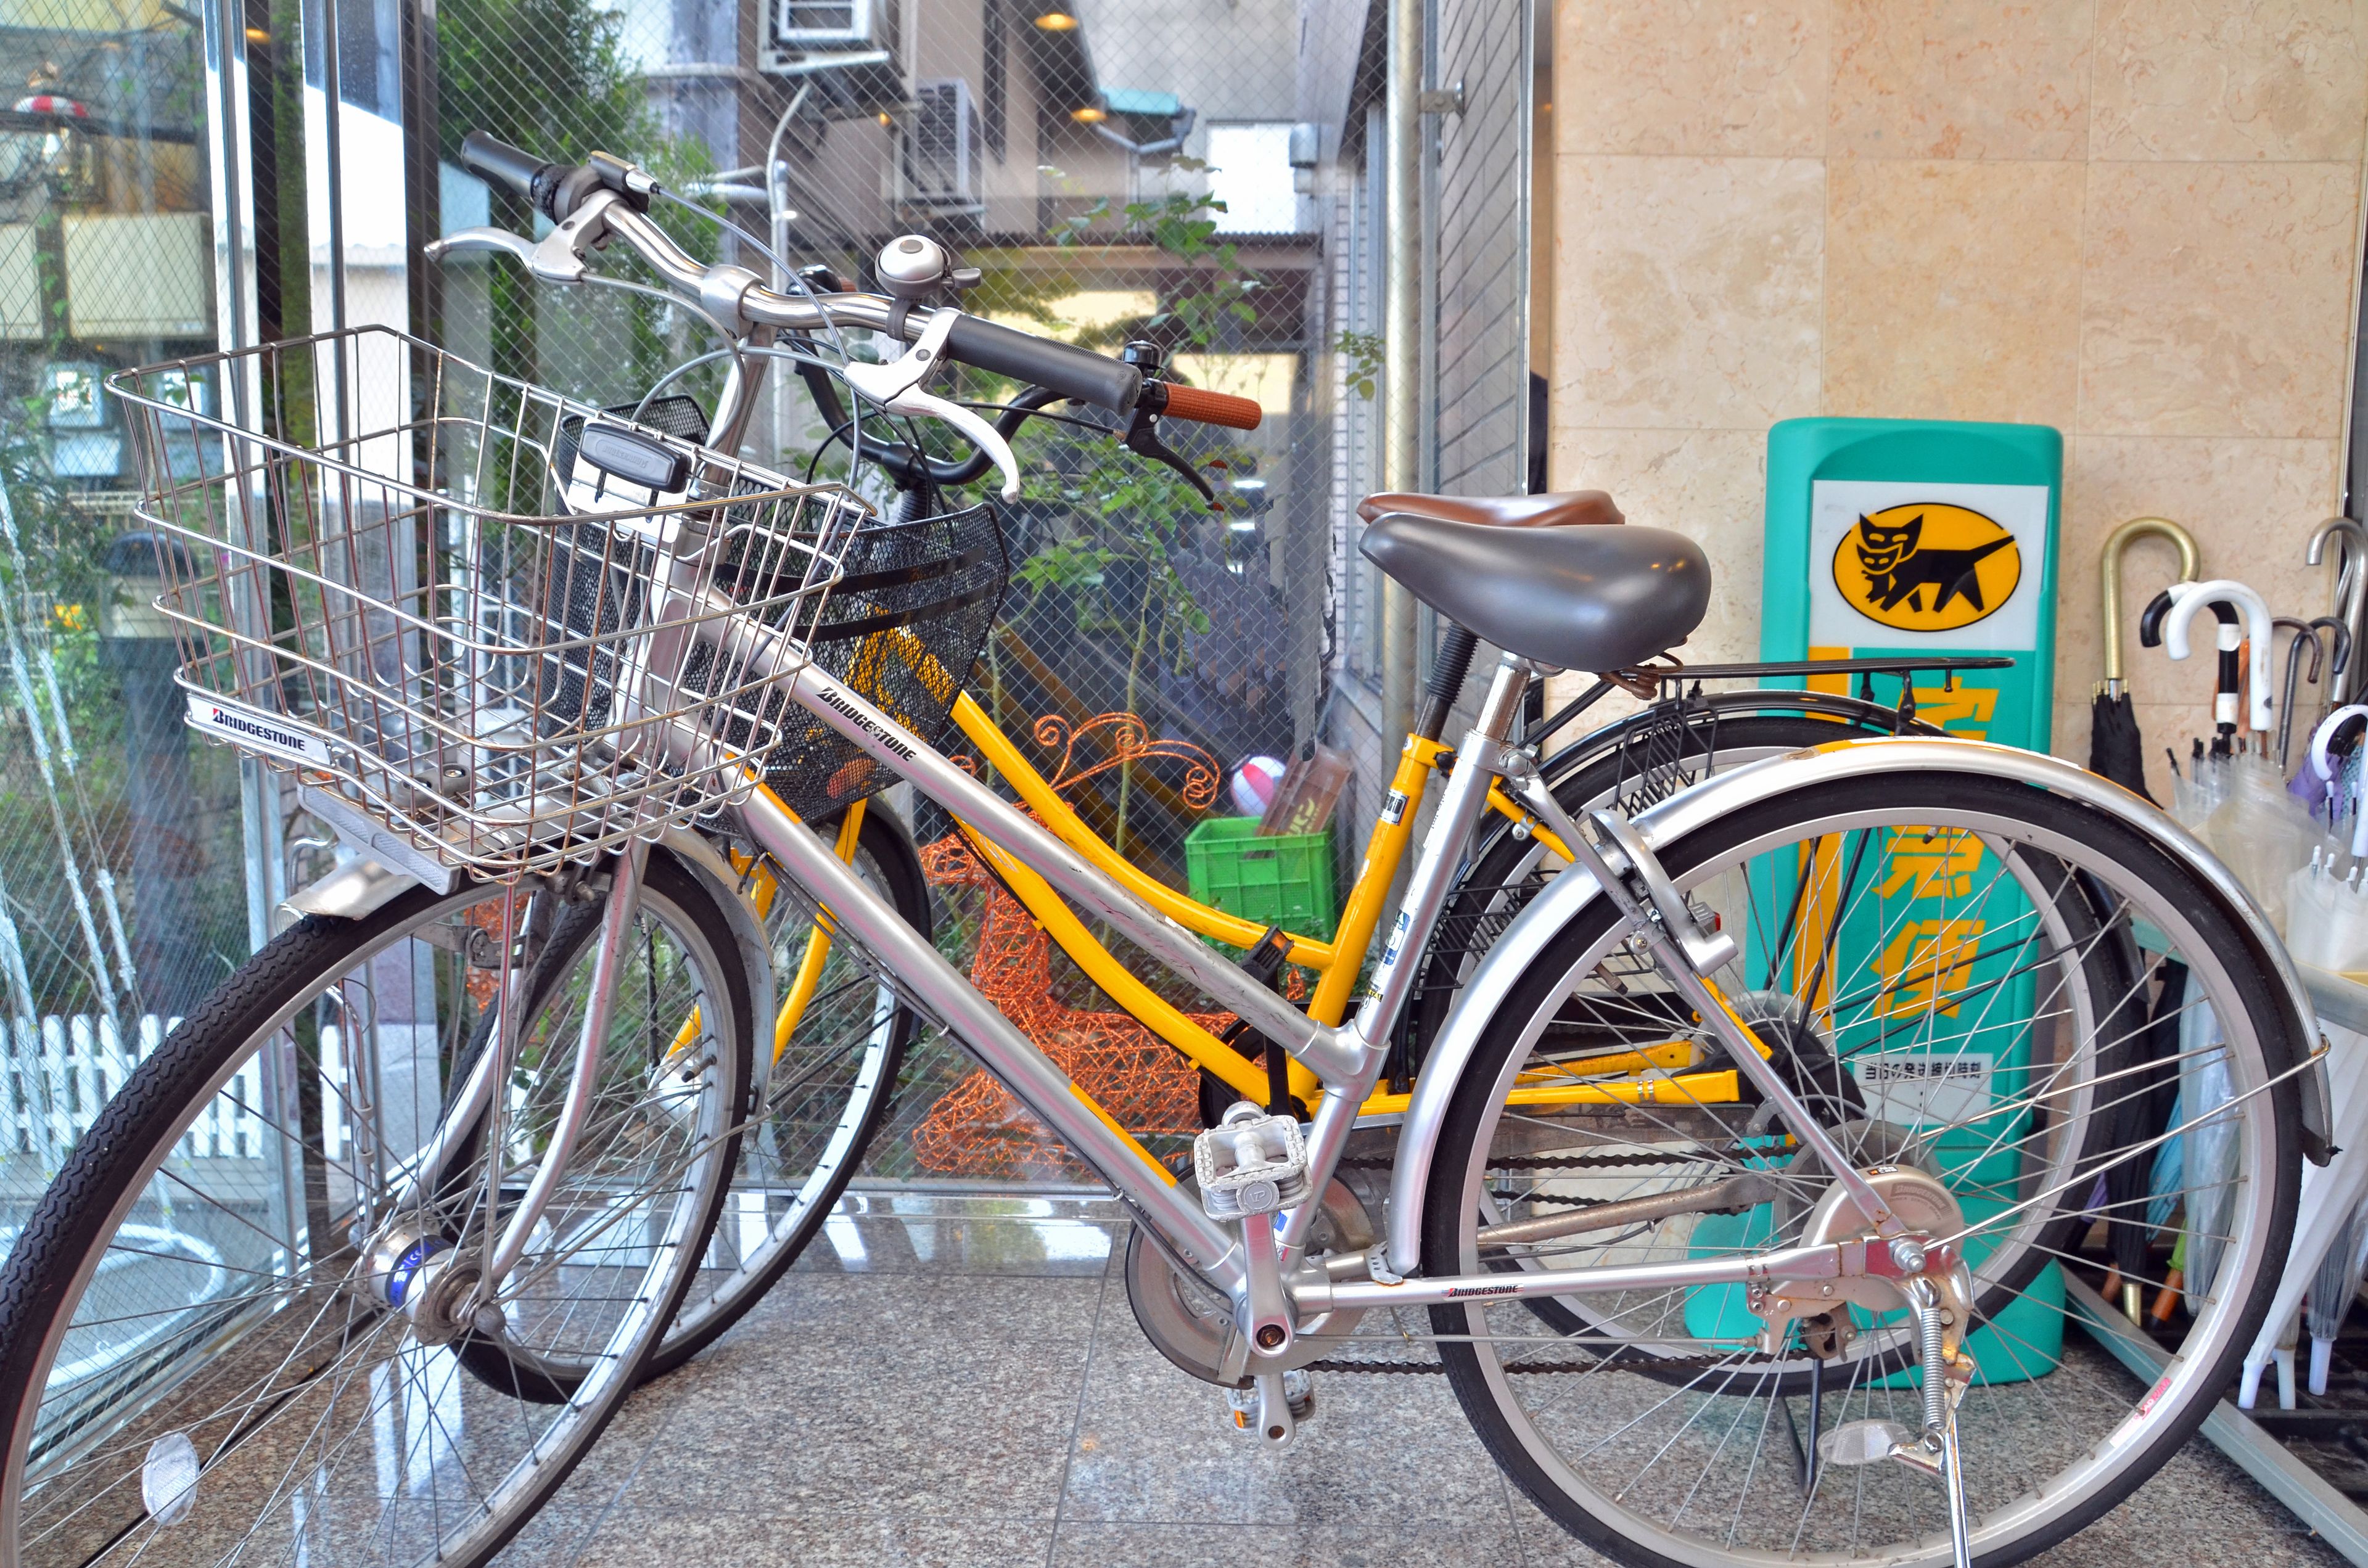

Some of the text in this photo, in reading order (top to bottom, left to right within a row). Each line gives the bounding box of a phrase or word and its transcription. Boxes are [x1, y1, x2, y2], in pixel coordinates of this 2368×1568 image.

[213, 707, 305, 751] BRIDGESTONE
[815, 686, 917, 761] BRIDGESTONE
[1447, 1285, 1519, 1298] BRIDGESTONE
